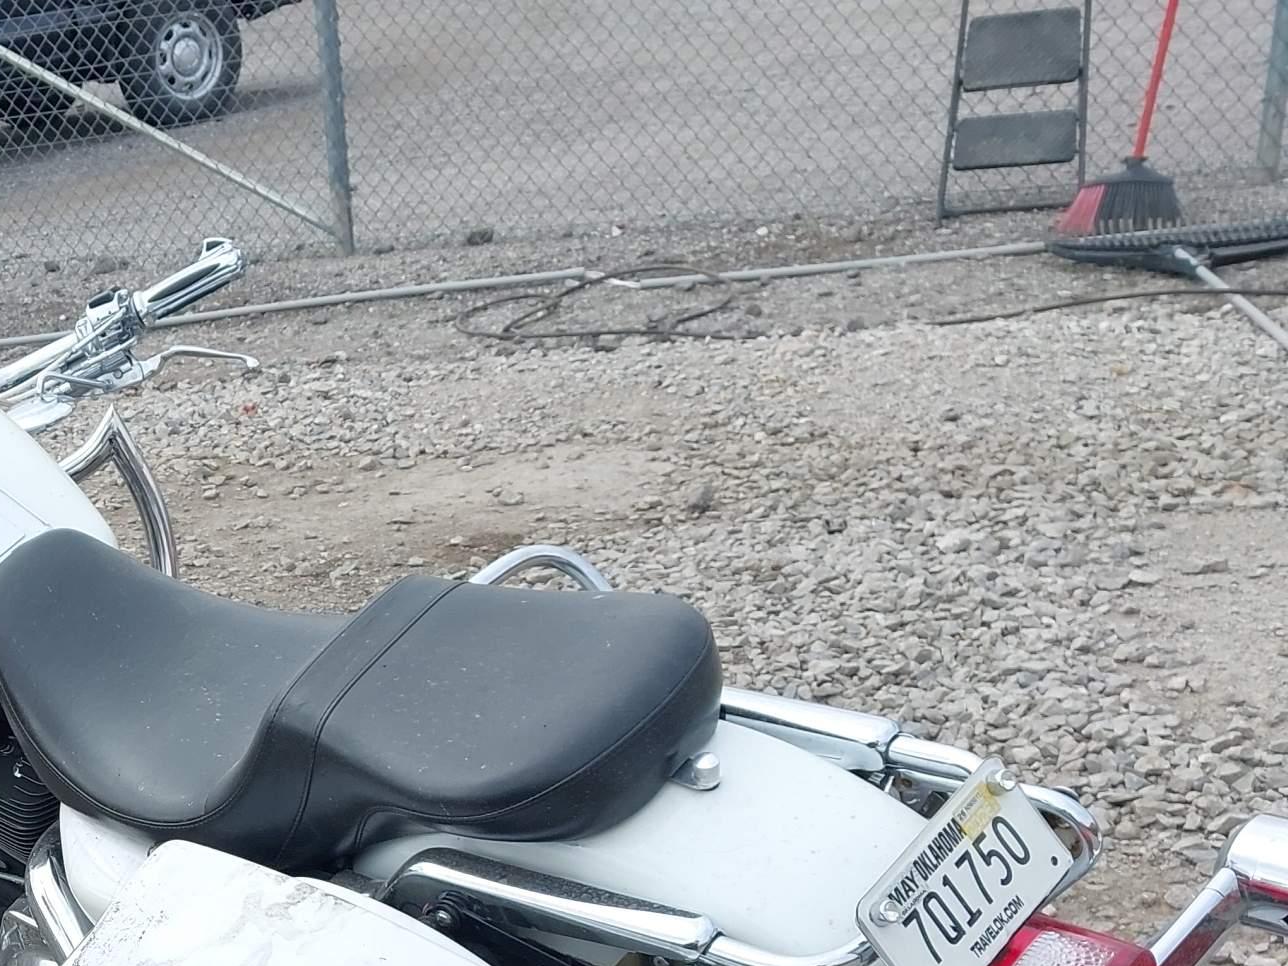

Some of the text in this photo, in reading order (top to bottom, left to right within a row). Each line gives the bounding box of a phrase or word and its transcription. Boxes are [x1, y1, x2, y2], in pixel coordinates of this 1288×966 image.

[888, 818, 967, 907] MAY OKLAHOMA
[902, 815, 1030, 964] 7Q1750
[970, 895, 1025, 958] TRAVELOK.COM
